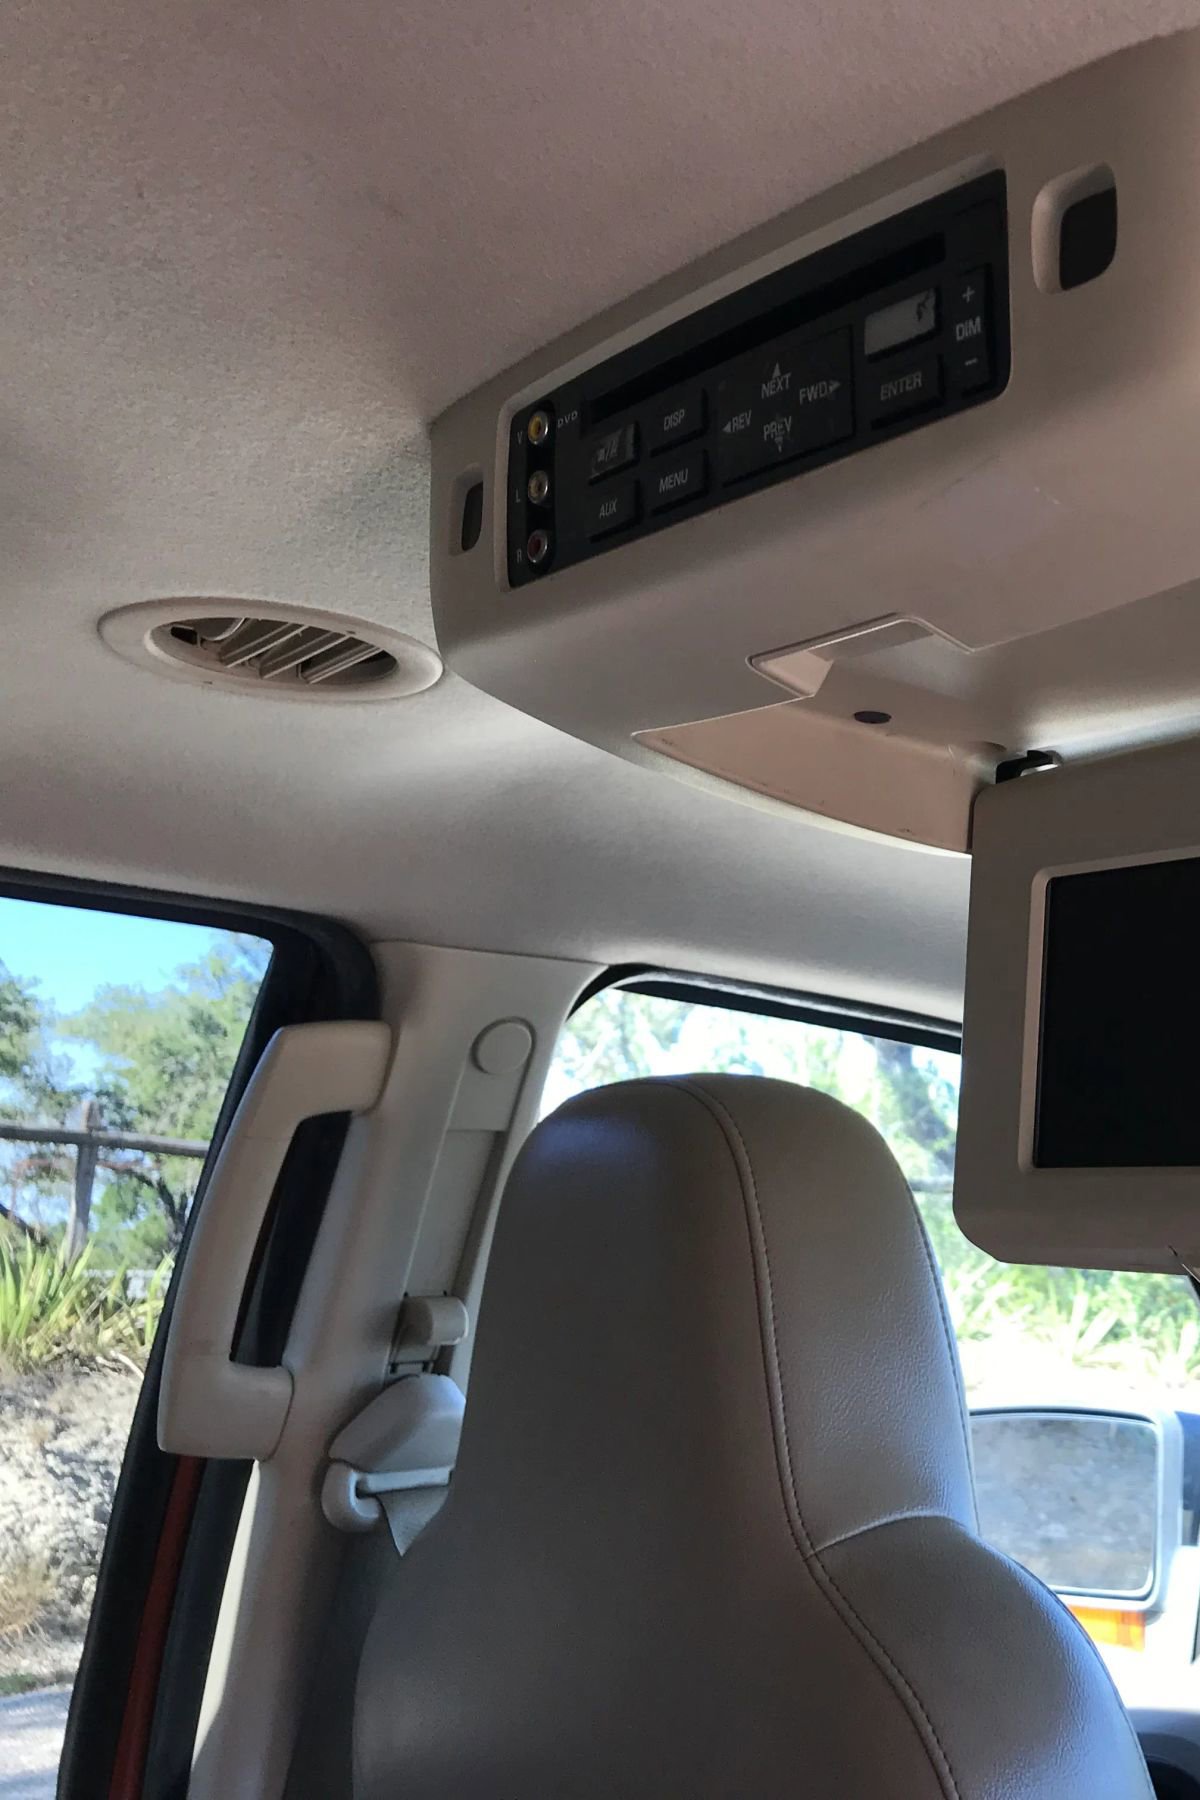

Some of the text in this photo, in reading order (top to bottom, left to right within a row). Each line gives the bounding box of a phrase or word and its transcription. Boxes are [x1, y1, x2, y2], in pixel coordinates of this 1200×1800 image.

[955, 316, 982, 342] DIM
[761, 372, 792, 400] NEXT
[880, 371, 922, 401] ENTER
[557, 410, 578, 429] DVD
[663, 409, 686, 432] DISP
[731, 410, 752, 433] REV
[763, 416, 792, 441] PREV
[517, 431, 523, 445] V
[659, 468, 689, 494] MENU
[515, 489, 521, 504] L
[599, 498, 618, 519] AUX
[516, 548, 523, 563] R
